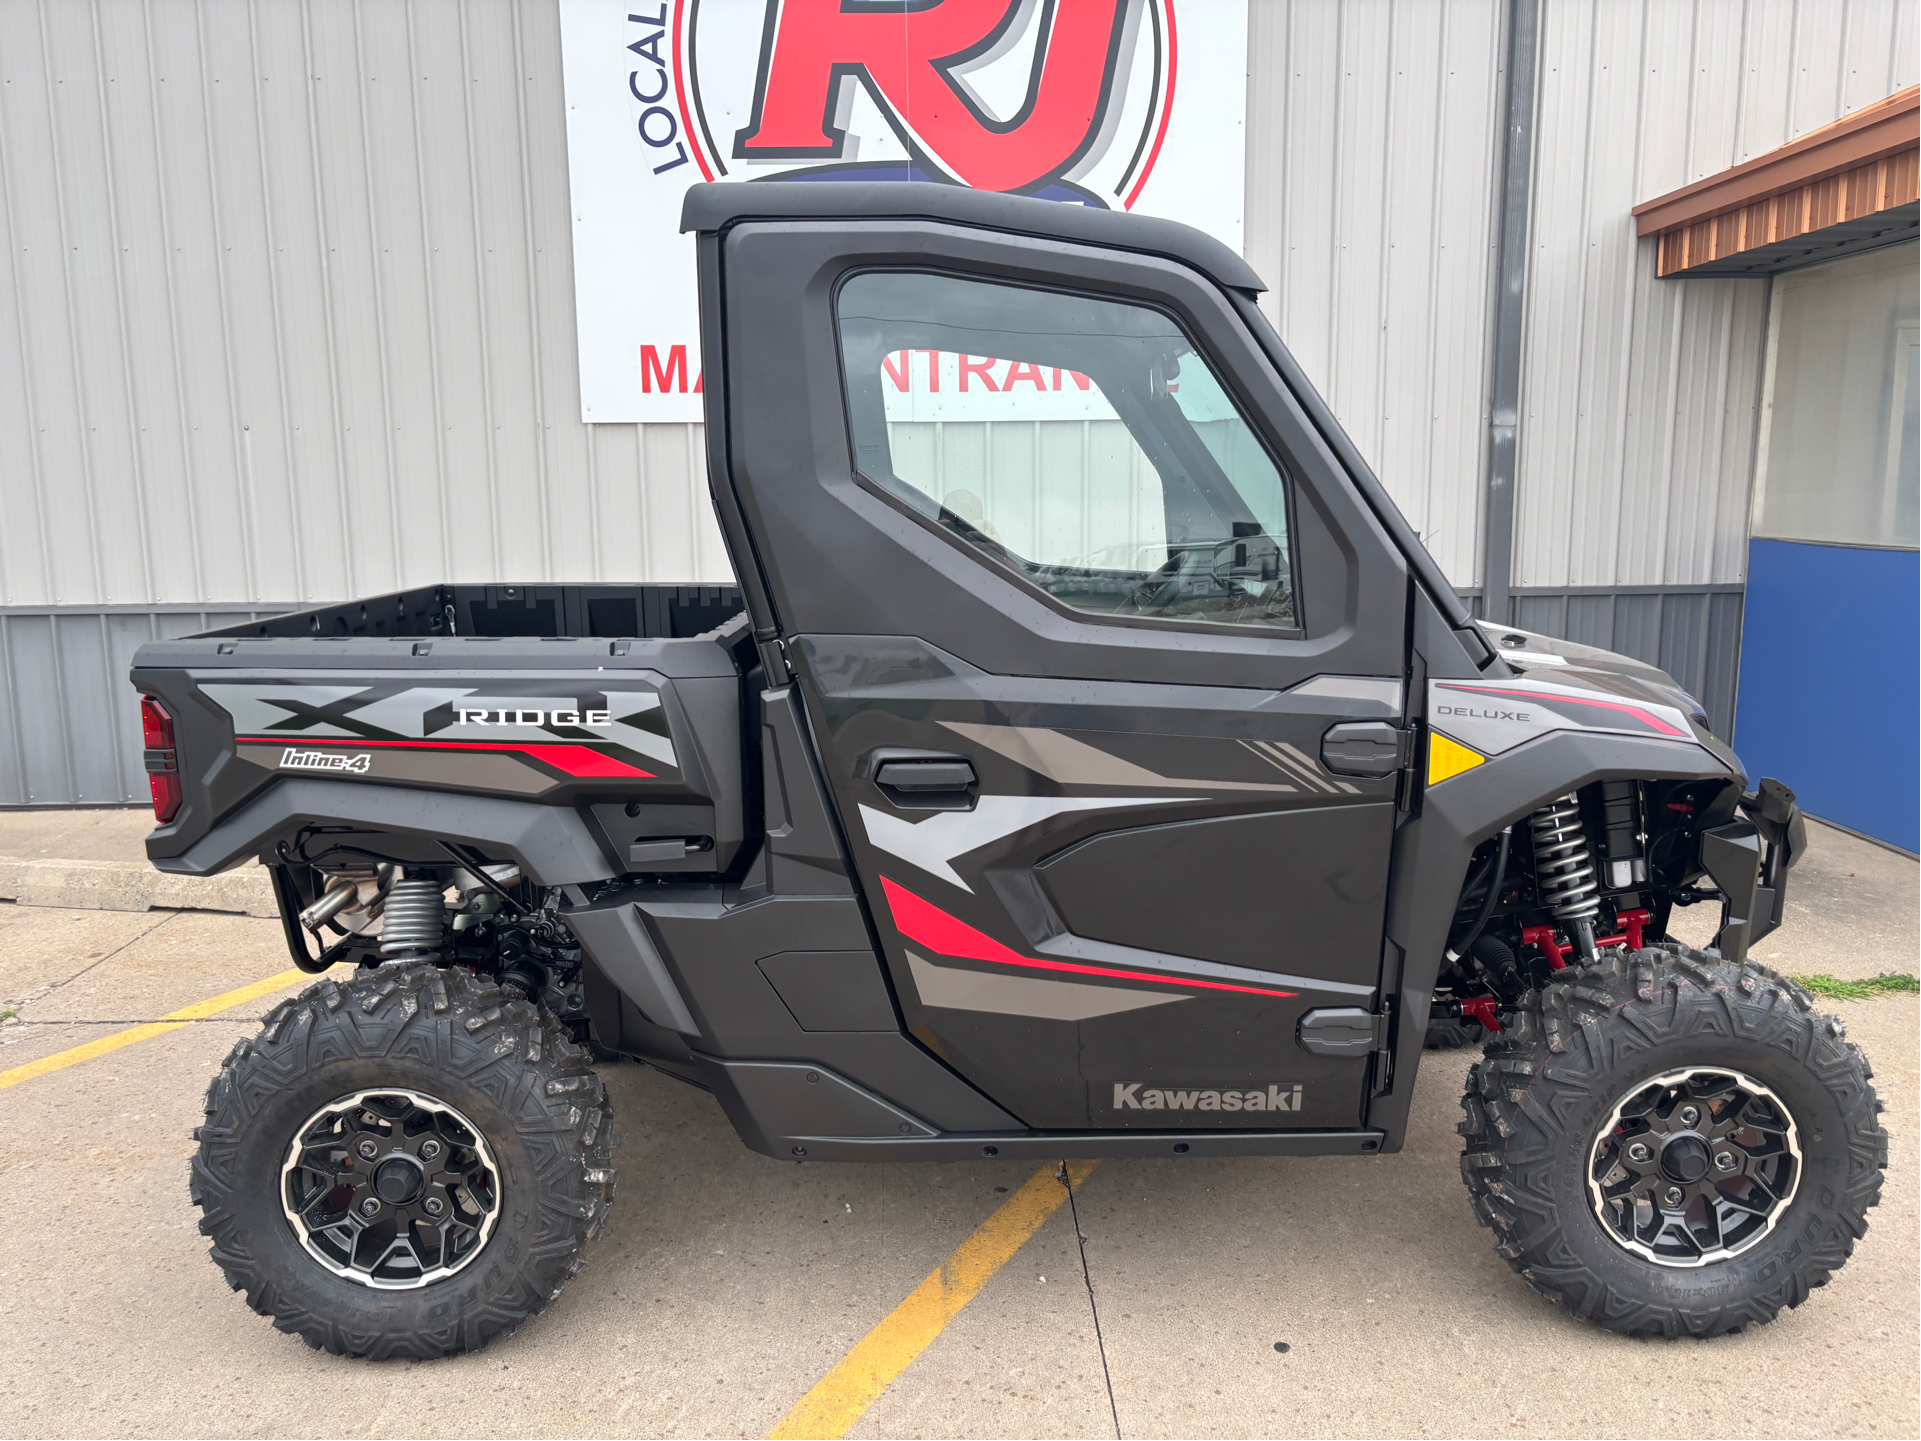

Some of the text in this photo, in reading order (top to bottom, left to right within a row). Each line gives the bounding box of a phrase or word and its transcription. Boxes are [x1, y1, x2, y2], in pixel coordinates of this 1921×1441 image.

[459, 709, 612, 726] RIDGE
[1437, 705, 1531, 722] DELUXE
[279, 748, 371, 773] Inline-4
[1113, 1083, 1303, 1111] Kawasaki
